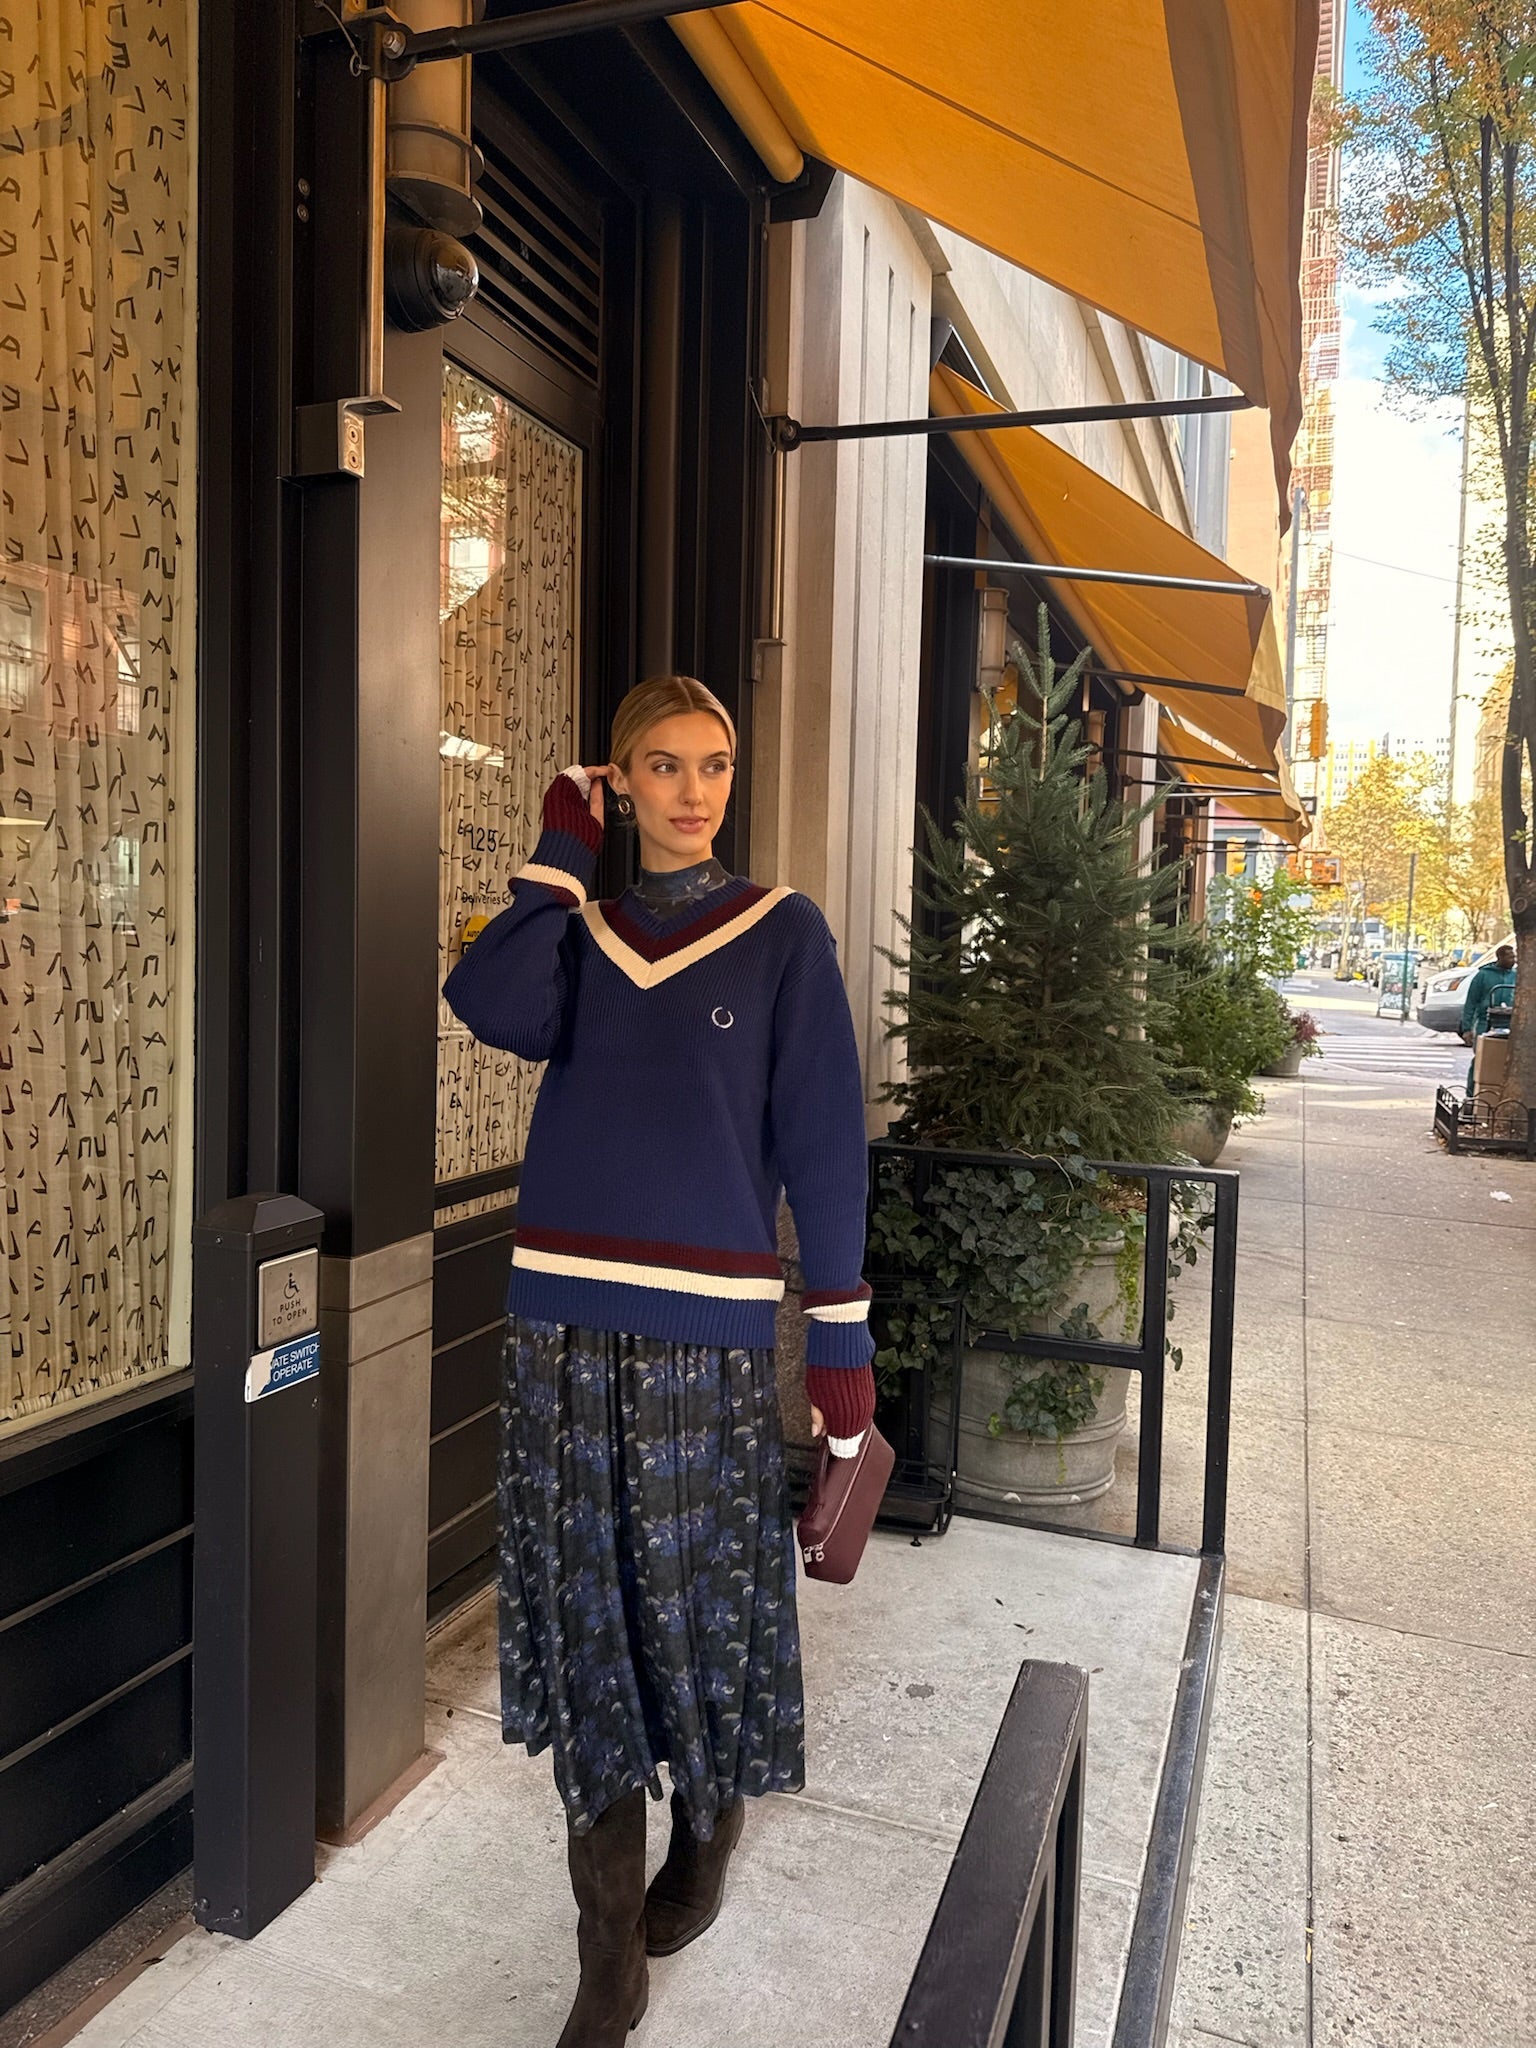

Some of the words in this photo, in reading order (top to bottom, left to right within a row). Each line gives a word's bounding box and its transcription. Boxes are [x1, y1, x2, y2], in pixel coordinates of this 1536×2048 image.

[279, 1299, 301, 1312] PUSH
[272, 1316, 283, 1326] TO
[286, 1308, 308, 1321] OPEN
[272, 1357, 313, 1382] OPERATE
